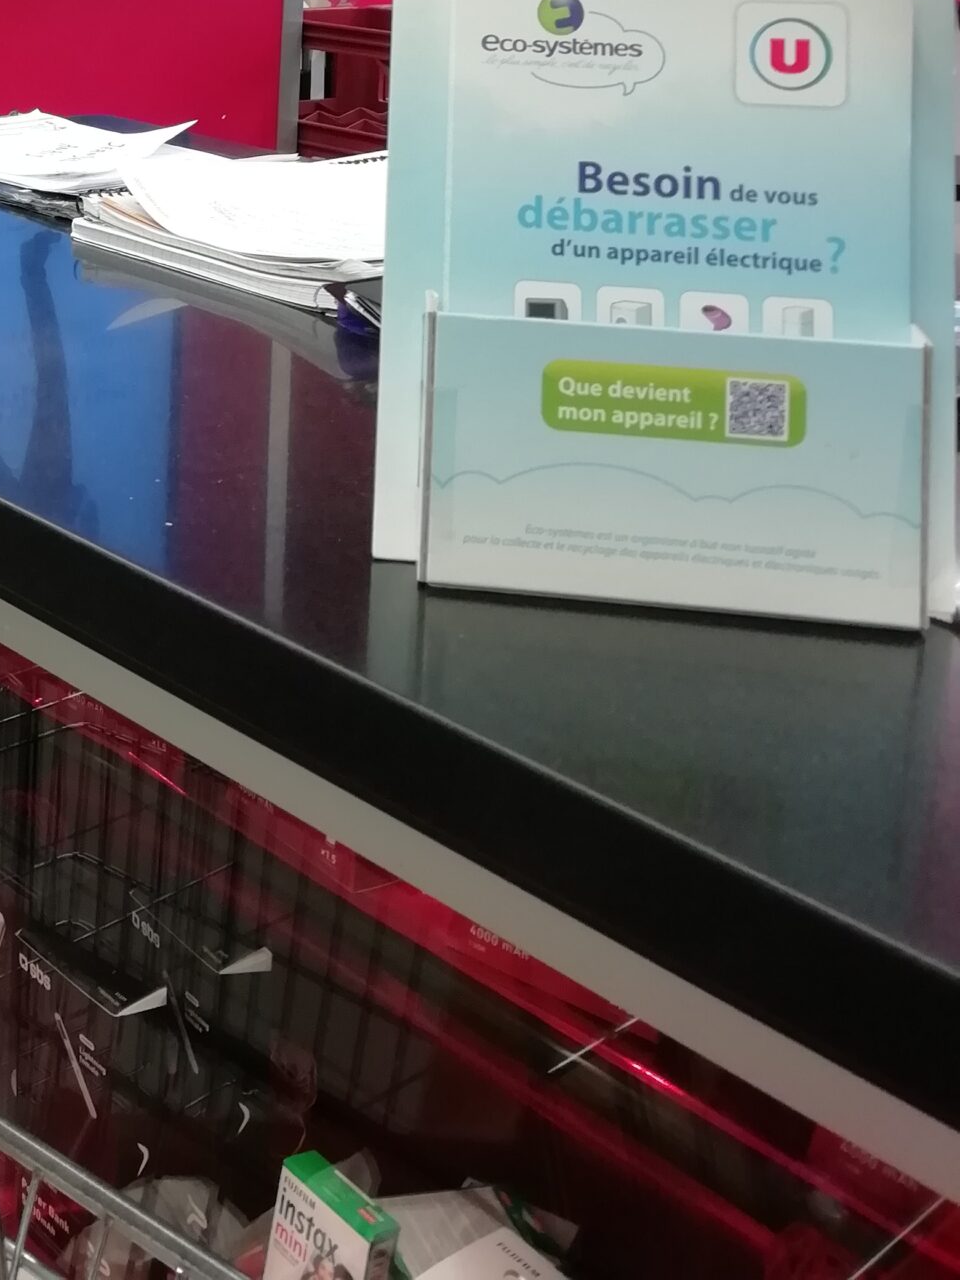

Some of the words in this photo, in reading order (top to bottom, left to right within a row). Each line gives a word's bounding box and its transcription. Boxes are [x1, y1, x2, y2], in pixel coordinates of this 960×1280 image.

[481, 32, 643, 59] eco-systèmes
[770, 38, 810, 74] U
[577, 160, 721, 201] Besoin
[730, 184, 759, 204] de
[764, 191, 819, 207] vous
[517, 195, 777, 243] débarrasser
[551, 238, 601, 260] d'un
[606, 246, 700, 267] appareil
[705, 249, 823, 276] électrique
[826, 236, 846, 274] ?
[558, 376, 603, 397] Que
[608, 380, 691, 403] devient
[558, 405, 606, 423] mon
[611, 407, 703, 430] appareil
[708, 412, 719, 431] ?
[469, 924, 499, 947] 4000
[275, 1221, 309, 1263] mini
[279, 1187, 339, 1266] instax
